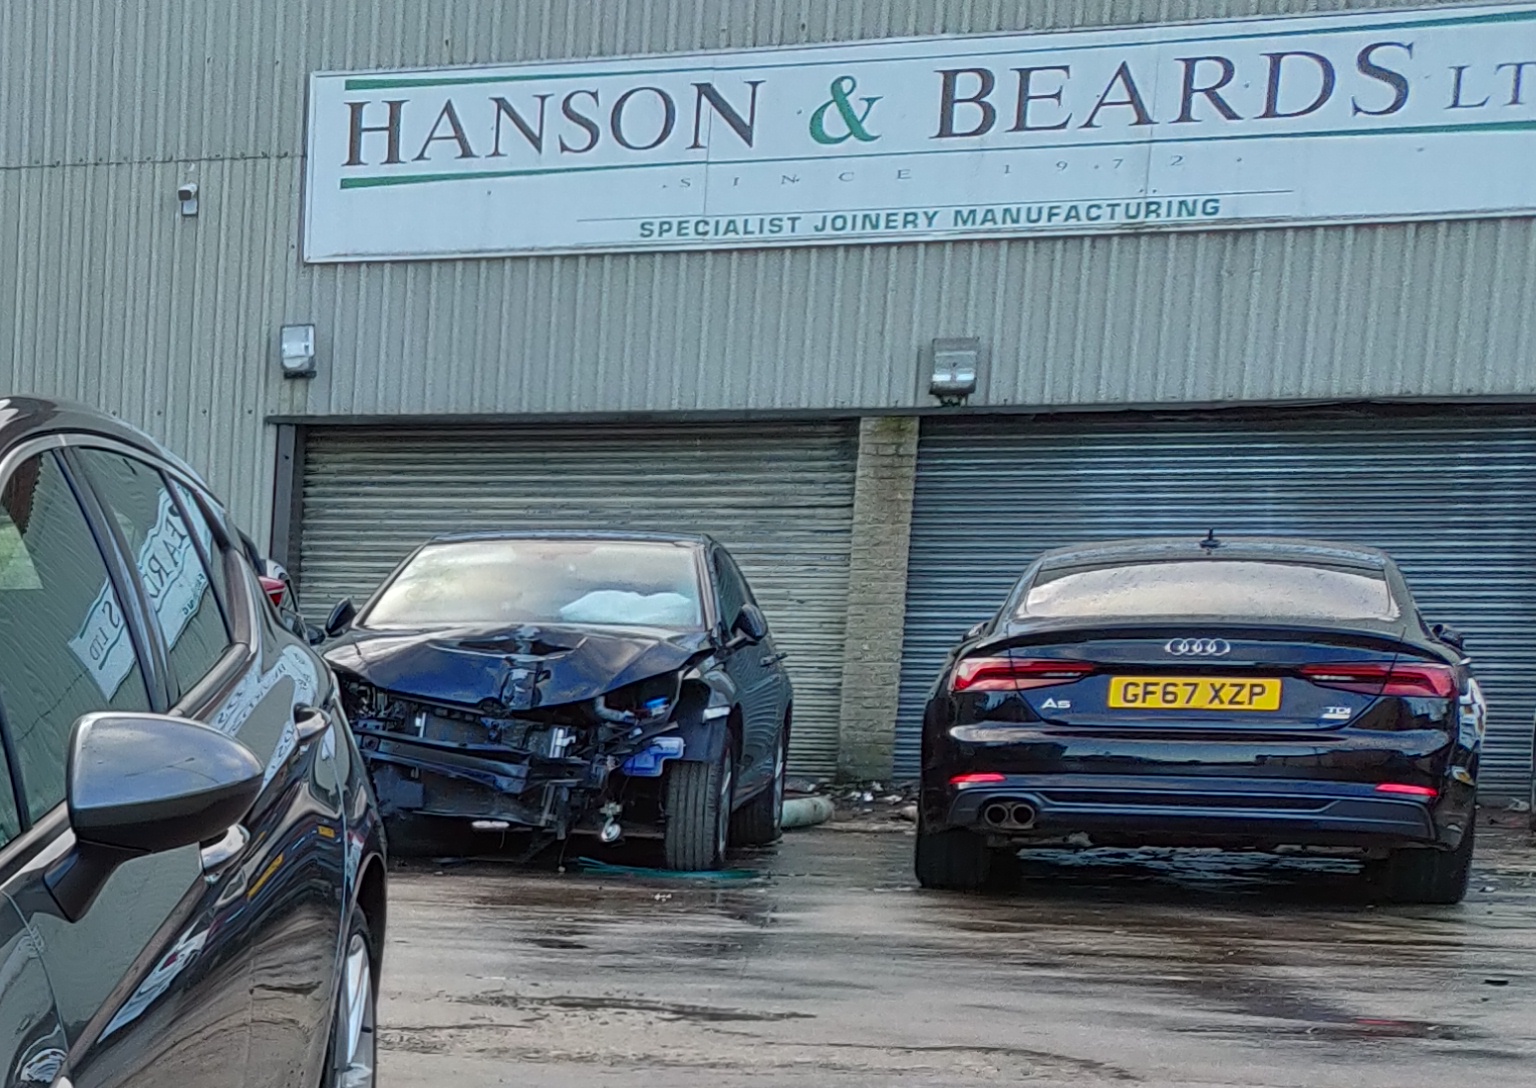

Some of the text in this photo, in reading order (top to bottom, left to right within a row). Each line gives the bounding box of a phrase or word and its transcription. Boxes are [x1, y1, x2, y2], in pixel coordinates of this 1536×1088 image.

[341, 41, 1536, 167] HANSON & BEARDS LT
[679, 154, 1185, 189] SINCE 1972
[639, 198, 1221, 239] SPECIALIST JOINERY MANUFACTURING
[1122, 682, 1266, 706] GF67 XZP
